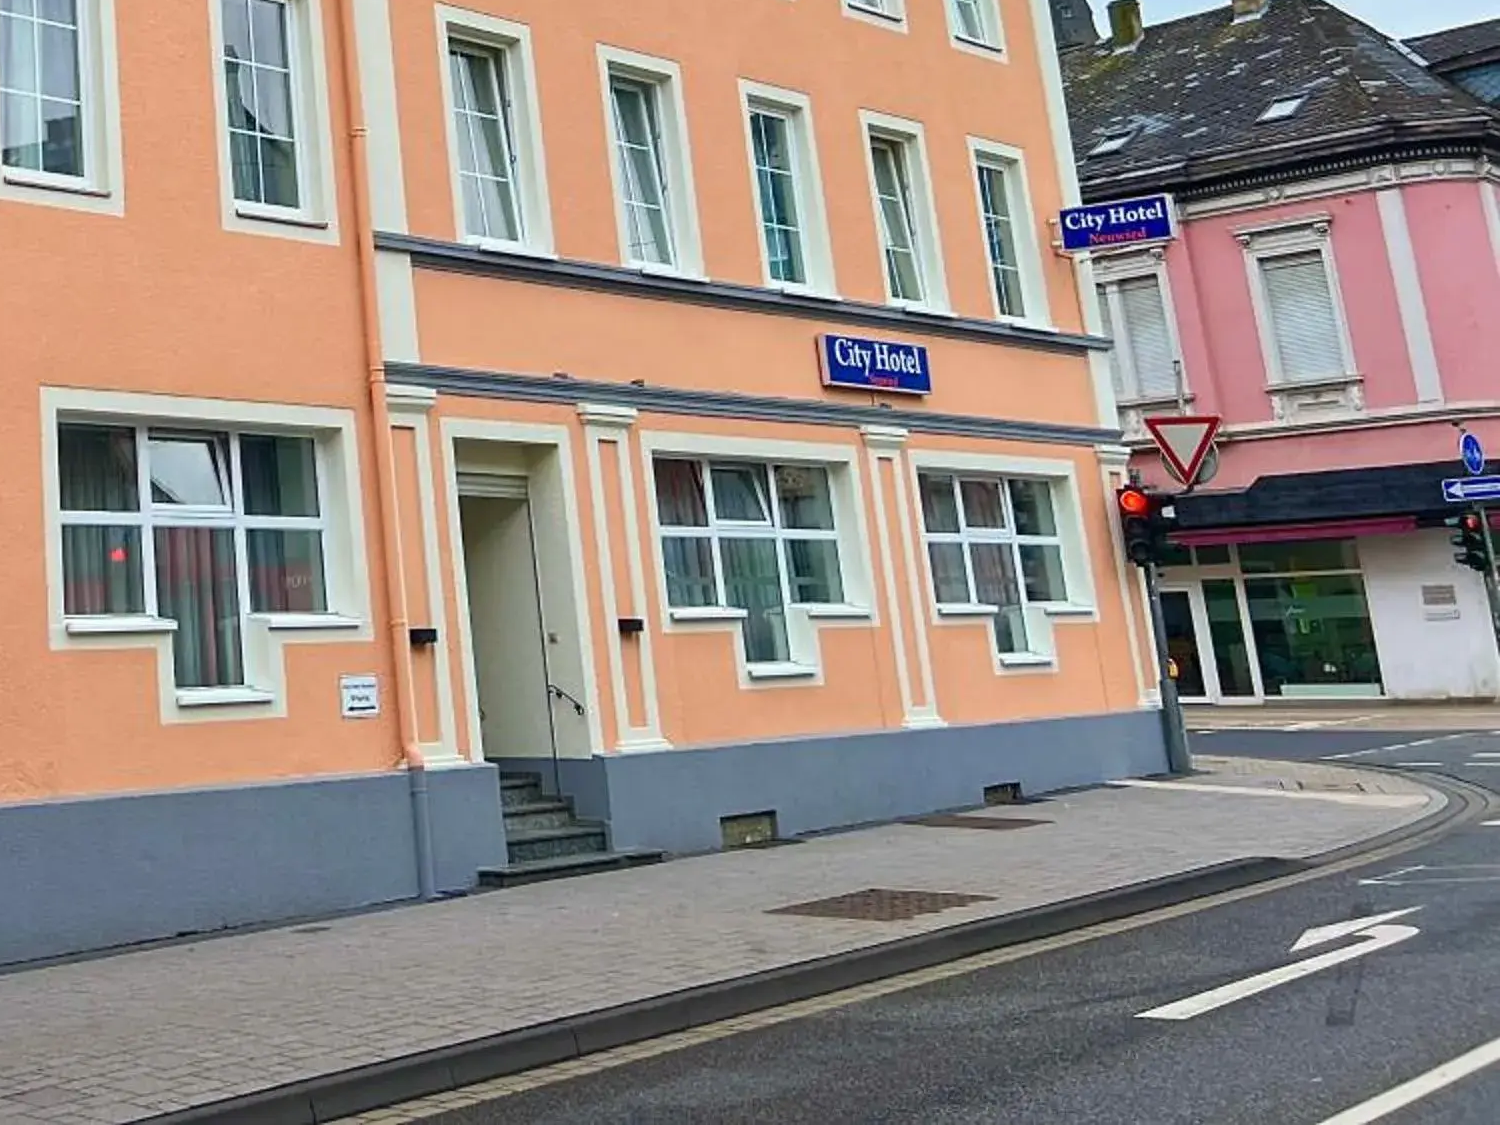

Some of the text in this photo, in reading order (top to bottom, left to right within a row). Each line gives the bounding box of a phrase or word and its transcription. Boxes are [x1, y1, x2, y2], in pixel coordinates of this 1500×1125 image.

[1065, 201, 1164, 231] City Hotel
[835, 338, 921, 376] City Hotel
